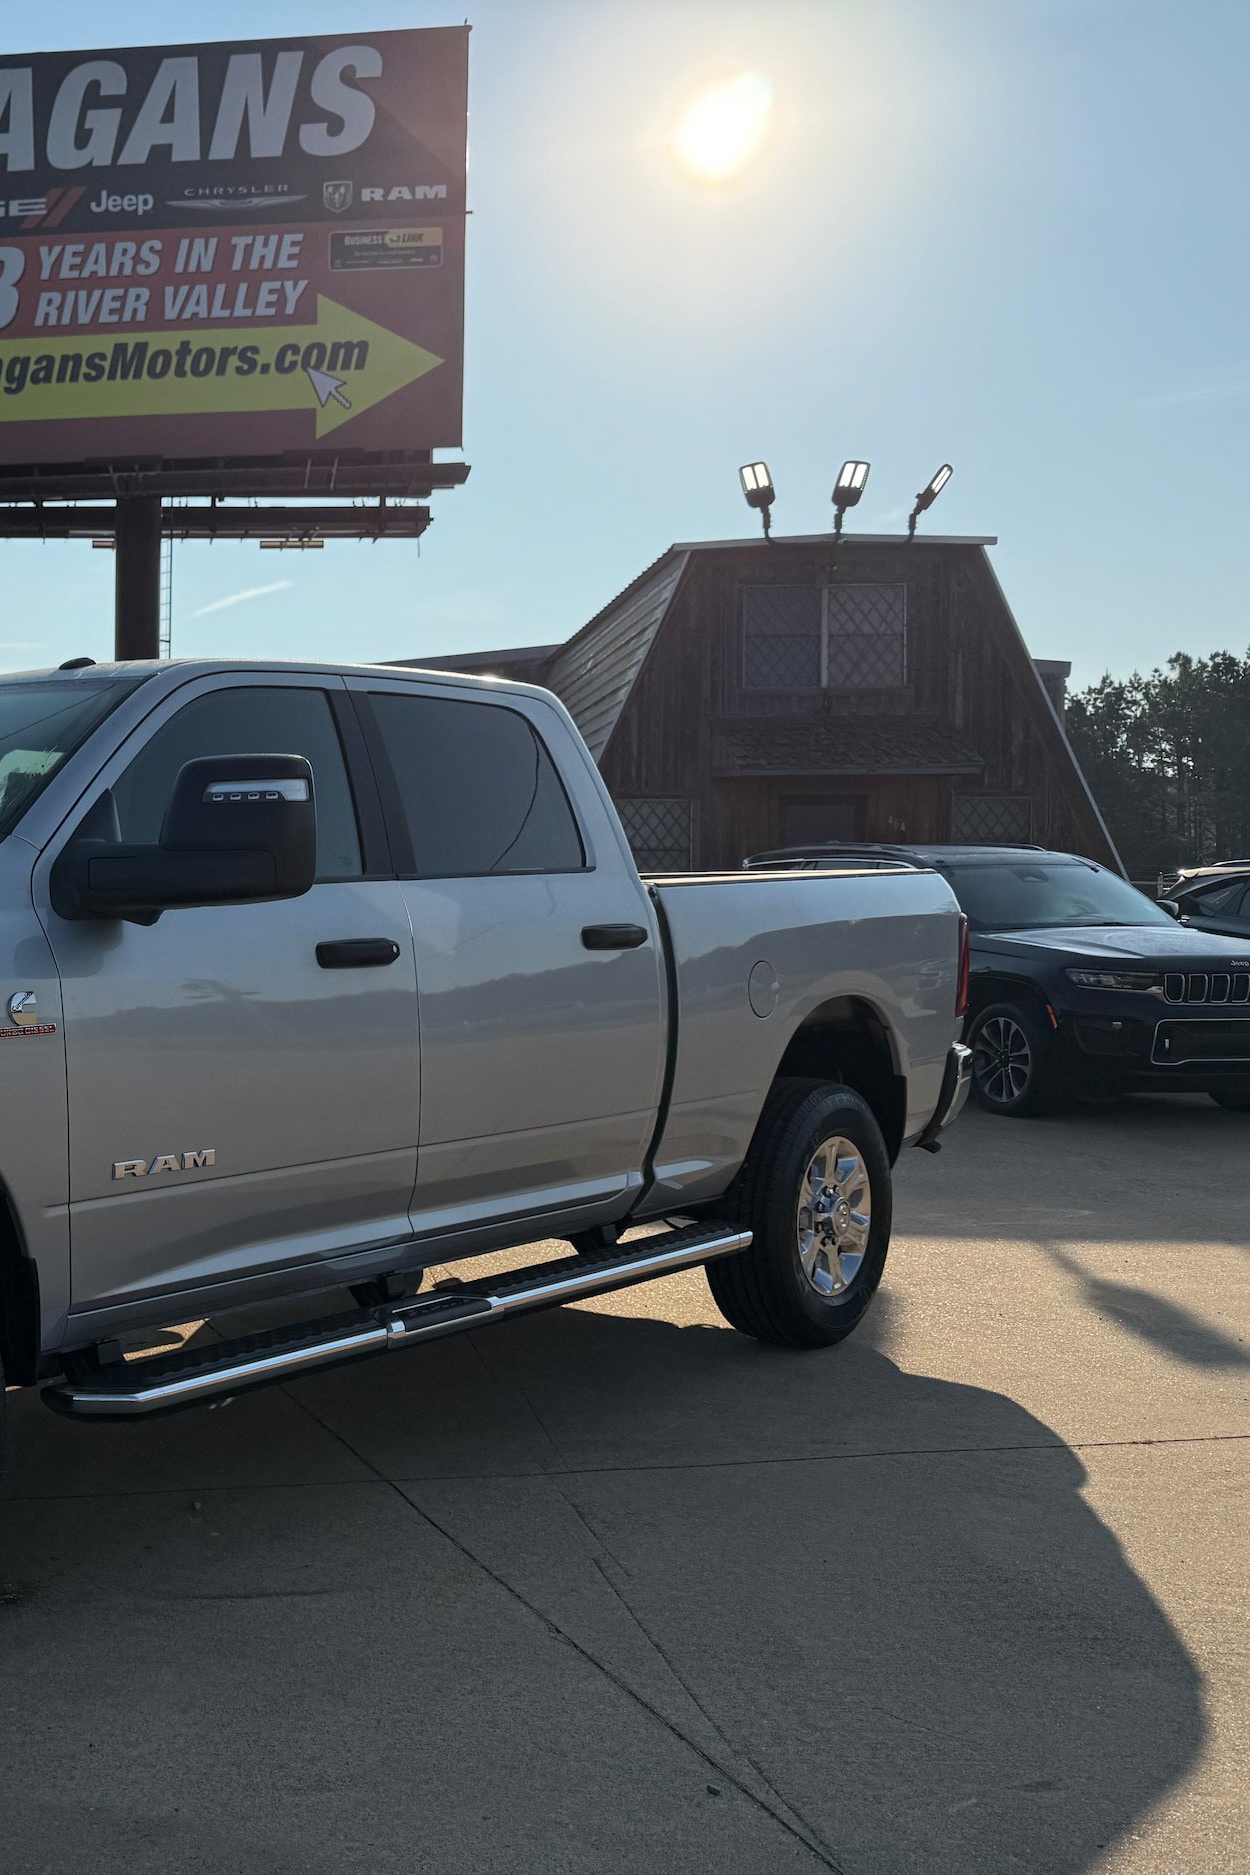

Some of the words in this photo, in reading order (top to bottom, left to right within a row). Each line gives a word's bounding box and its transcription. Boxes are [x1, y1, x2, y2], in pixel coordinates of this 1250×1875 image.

[90, 189, 154, 216] Jeep
[183, 184, 289, 197] CHRYSLER
[361, 184, 447, 202] RAM
[343, 235, 383, 246] BUSINESS
[39, 239, 163, 281] YEARS
[174, 237, 218, 273] IN
[231, 233, 304, 272] THE
[34, 287, 150, 327] RIVER
[163, 279, 309, 321] VALLEY
[112, 1149, 215, 1180] RAM
